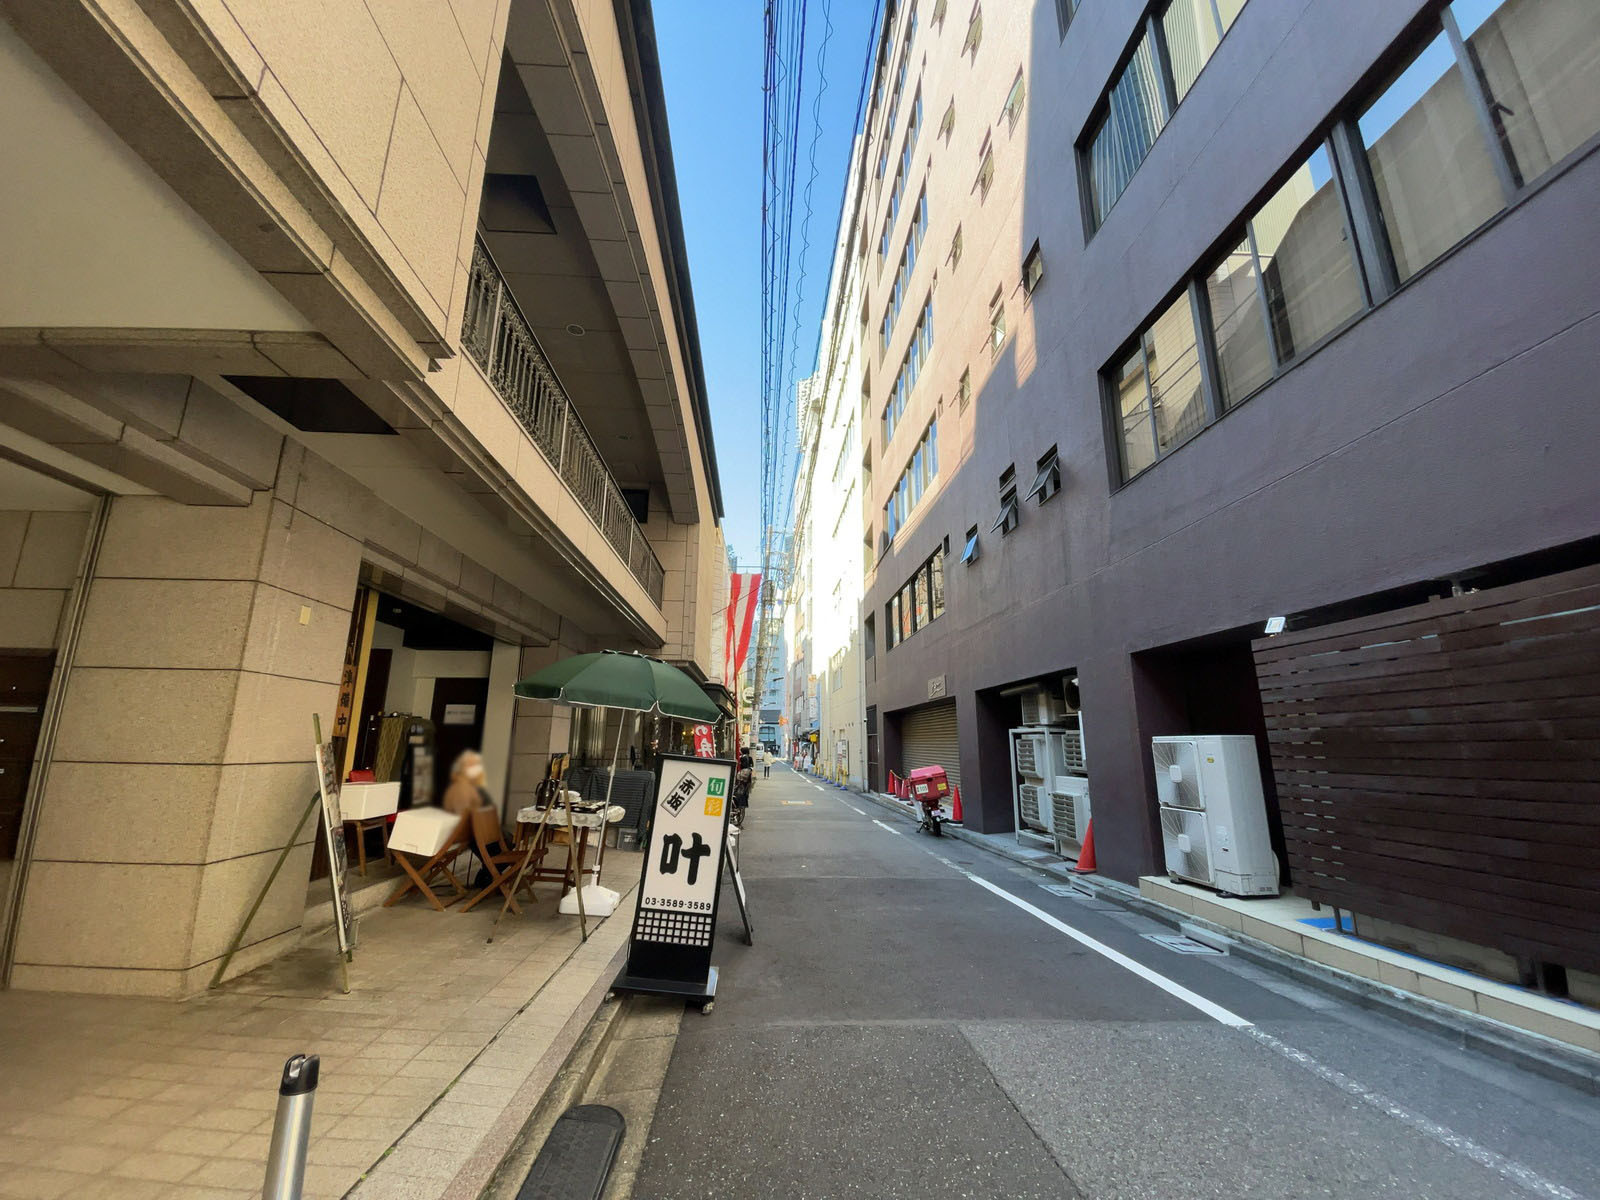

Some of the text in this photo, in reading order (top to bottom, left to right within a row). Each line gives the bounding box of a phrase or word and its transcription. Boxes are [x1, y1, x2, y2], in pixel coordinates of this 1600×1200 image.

[337, 669, 353, 732] 準備中
[666, 778, 696, 811] 赤坂
[659, 832, 711, 886] 叶
